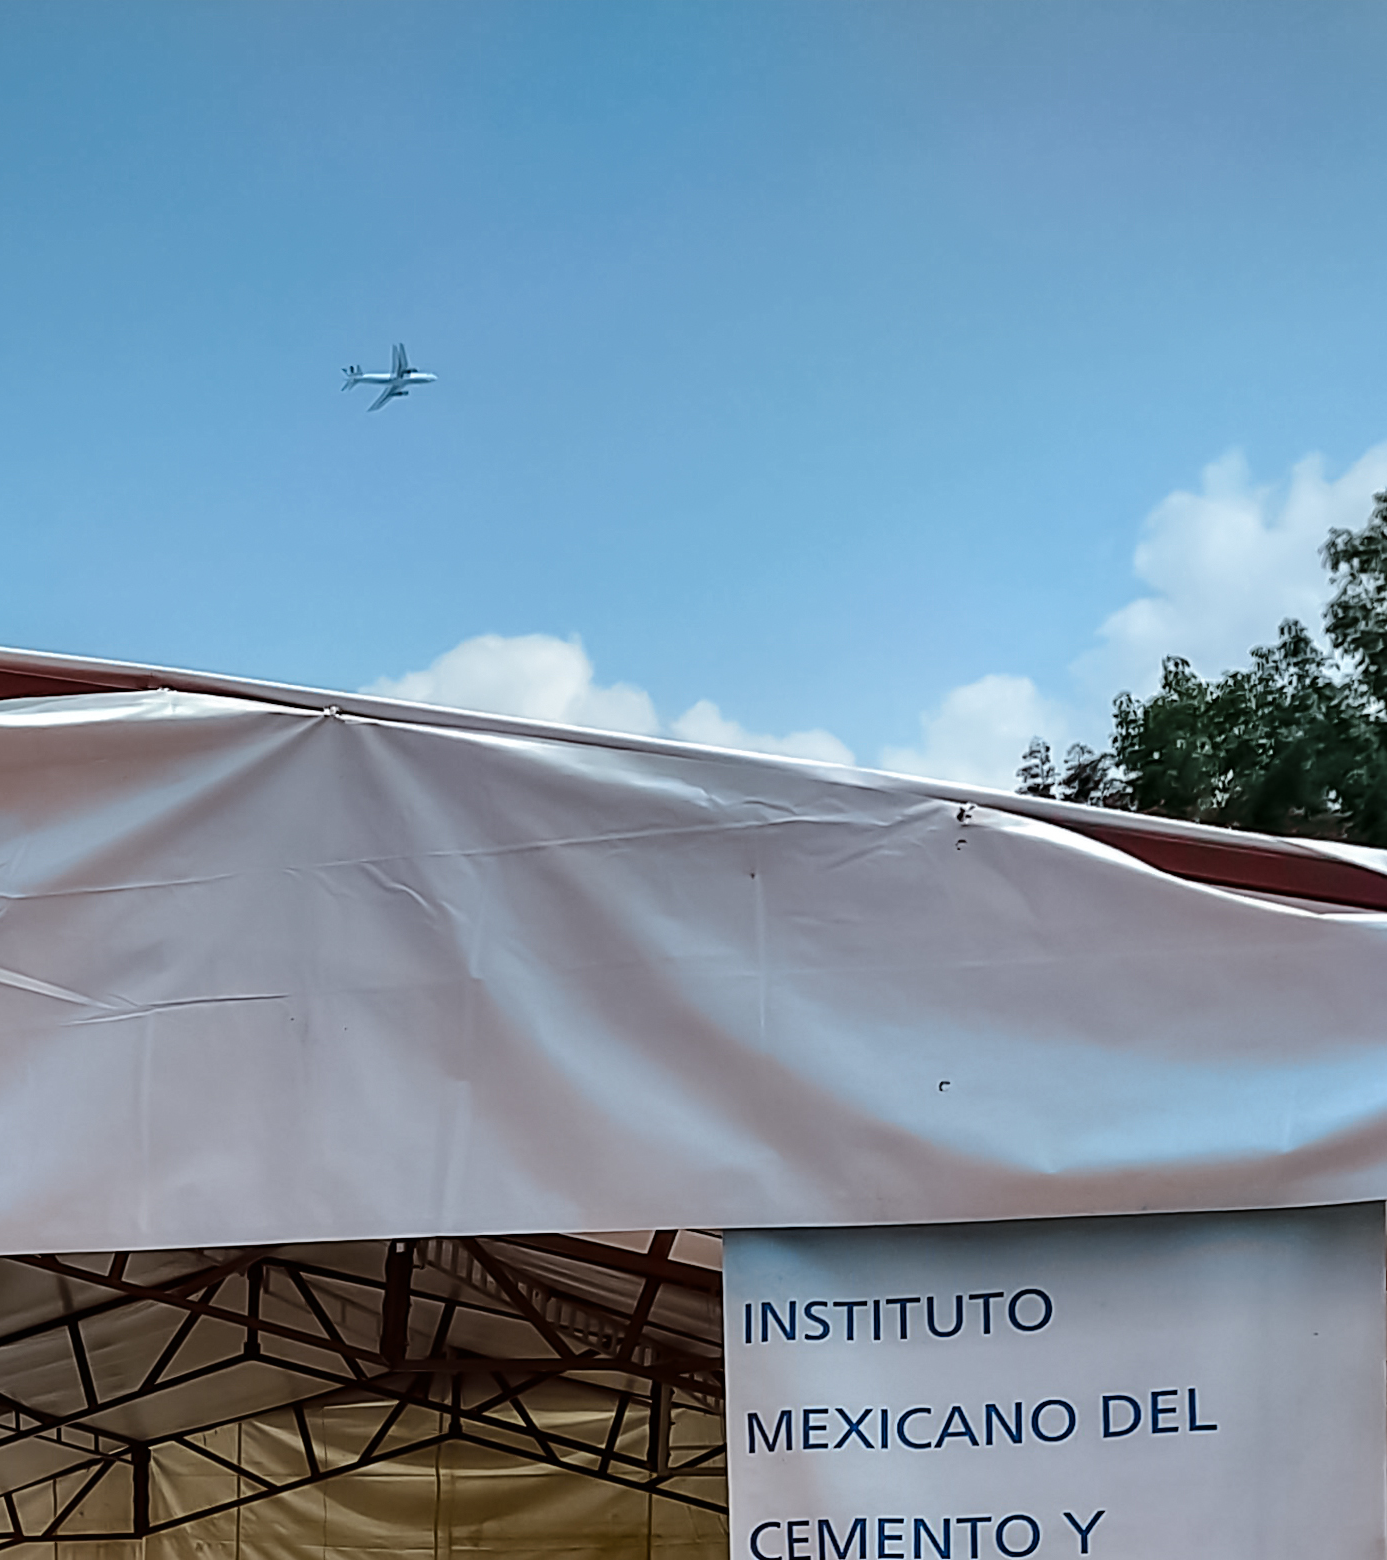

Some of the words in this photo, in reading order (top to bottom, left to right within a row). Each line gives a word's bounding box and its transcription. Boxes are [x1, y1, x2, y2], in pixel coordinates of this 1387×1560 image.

[743, 1288, 1053, 1344] INSTITUTO
[747, 1399, 1076, 1454] MEXICANO
[1102, 1387, 1218, 1438] DEL
[1063, 1510, 1106, 1554] Y
